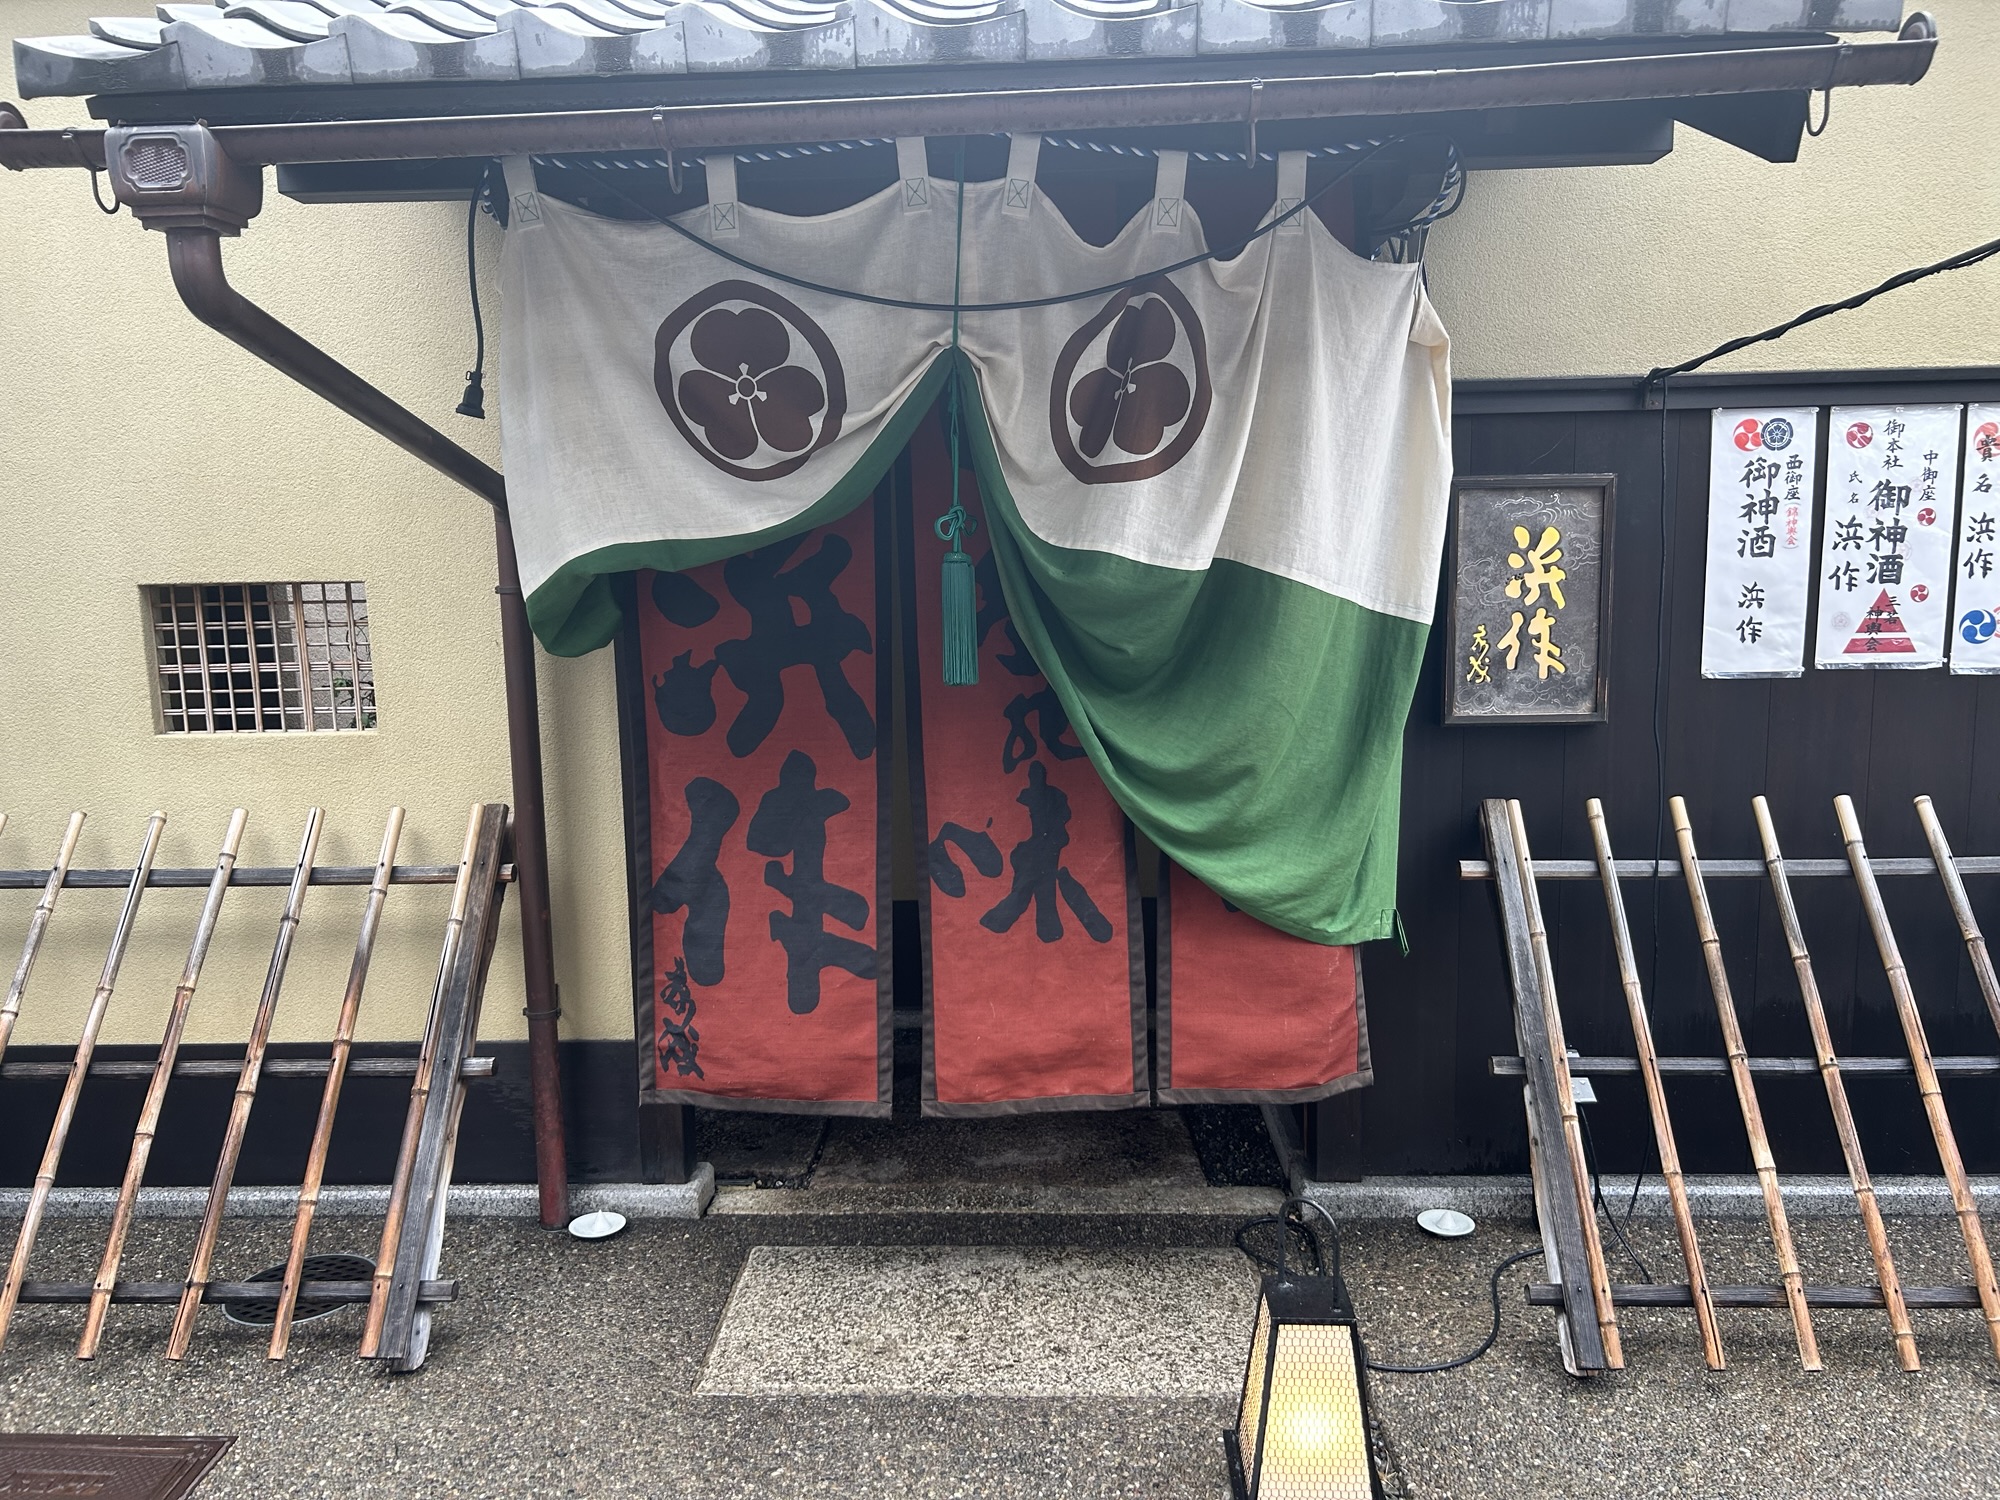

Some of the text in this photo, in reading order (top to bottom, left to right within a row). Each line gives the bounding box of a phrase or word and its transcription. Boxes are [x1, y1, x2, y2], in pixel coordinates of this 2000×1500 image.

[1882, 418, 1906, 471] 御本社
[1918, 449, 1940, 502] 中御座
[1784, 453, 1804, 501] 西御座
[1848, 470, 1863, 504] 氏名
[1735, 456, 1782, 644] 御神酒 浜作
[1828, 514, 1865, 593] 浜作
[1865, 478, 1913, 586] 御神酒
[1962, 510, 1997, 581] 浜作
[1496, 525, 1567, 681] 浜作
[1885, 595, 1902, 625] 三若
